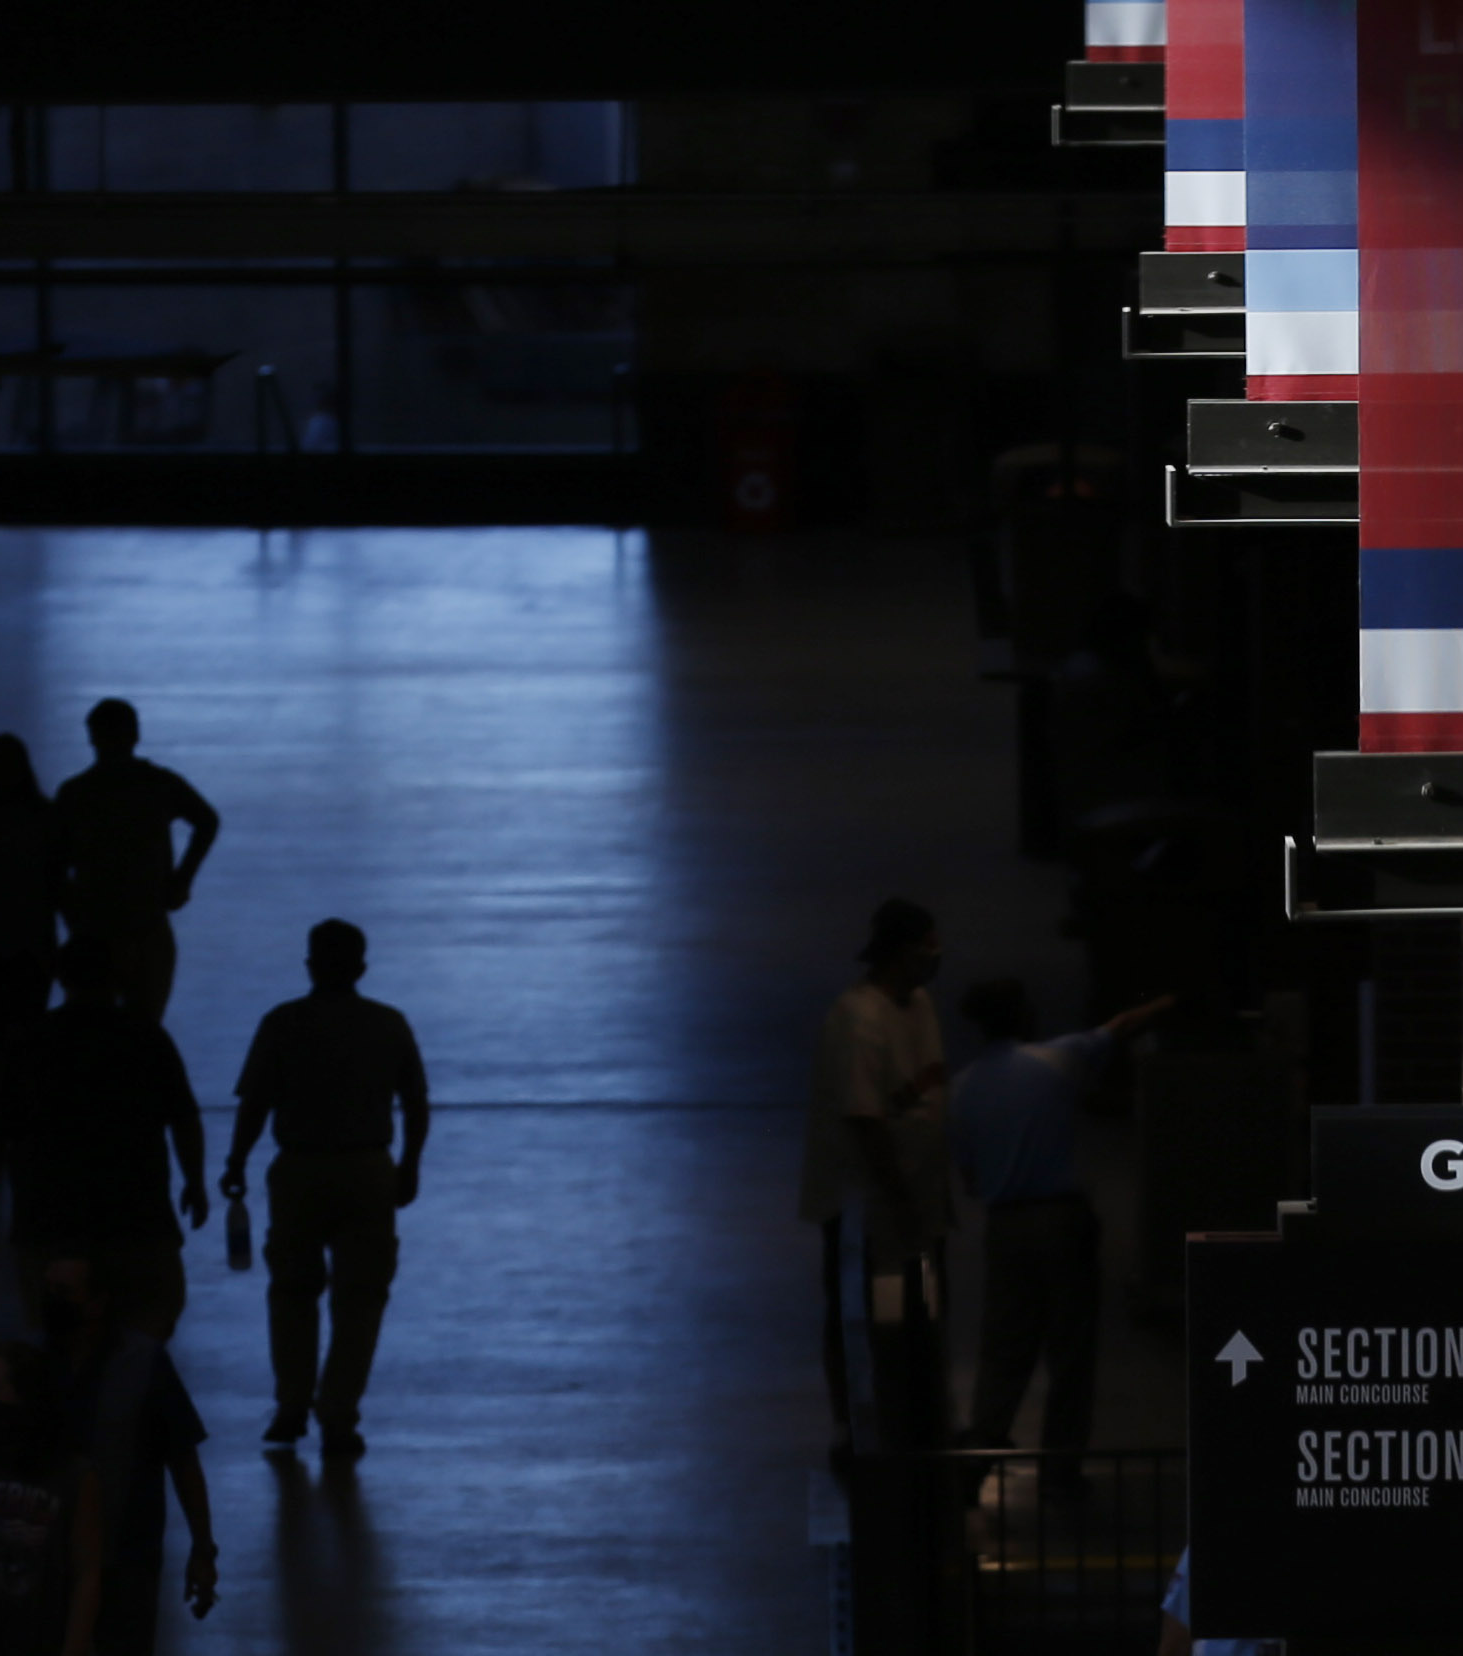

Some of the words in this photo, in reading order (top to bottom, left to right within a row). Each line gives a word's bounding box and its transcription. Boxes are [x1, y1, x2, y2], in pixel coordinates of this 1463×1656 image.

[1296, 1384, 1335, 1405] MAIN
[1339, 1384, 1430, 1405] CONCOURSE
[1296, 1487, 1335, 1507] MAIN
[1339, 1487, 1430, 1508] CONCOURSE
